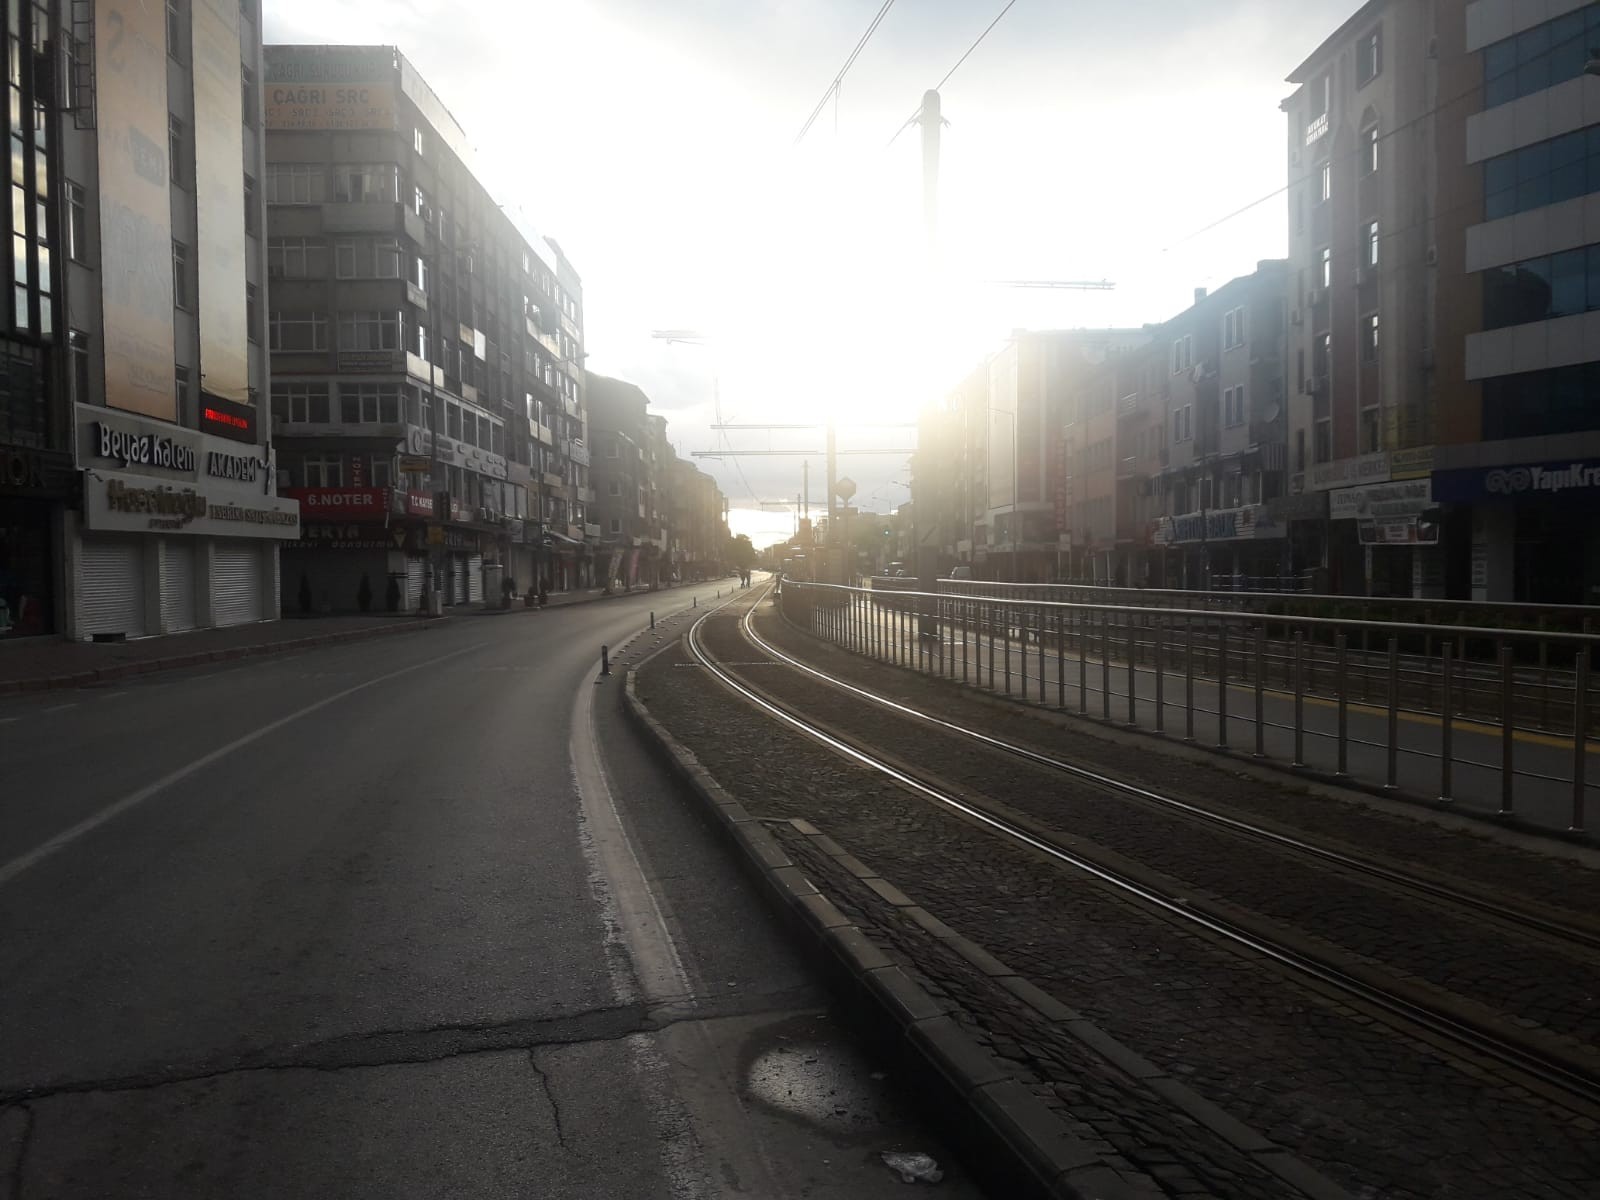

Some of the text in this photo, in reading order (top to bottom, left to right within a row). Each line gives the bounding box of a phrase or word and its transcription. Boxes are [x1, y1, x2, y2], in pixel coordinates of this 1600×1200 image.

[273, 86, 369, 105] ÇAĞRI SRC
[99, 422, 150, 468] Beyaz
[152, 435, 196, 472] Kalem
[307, 493, 373, 506] 6.NOTER
